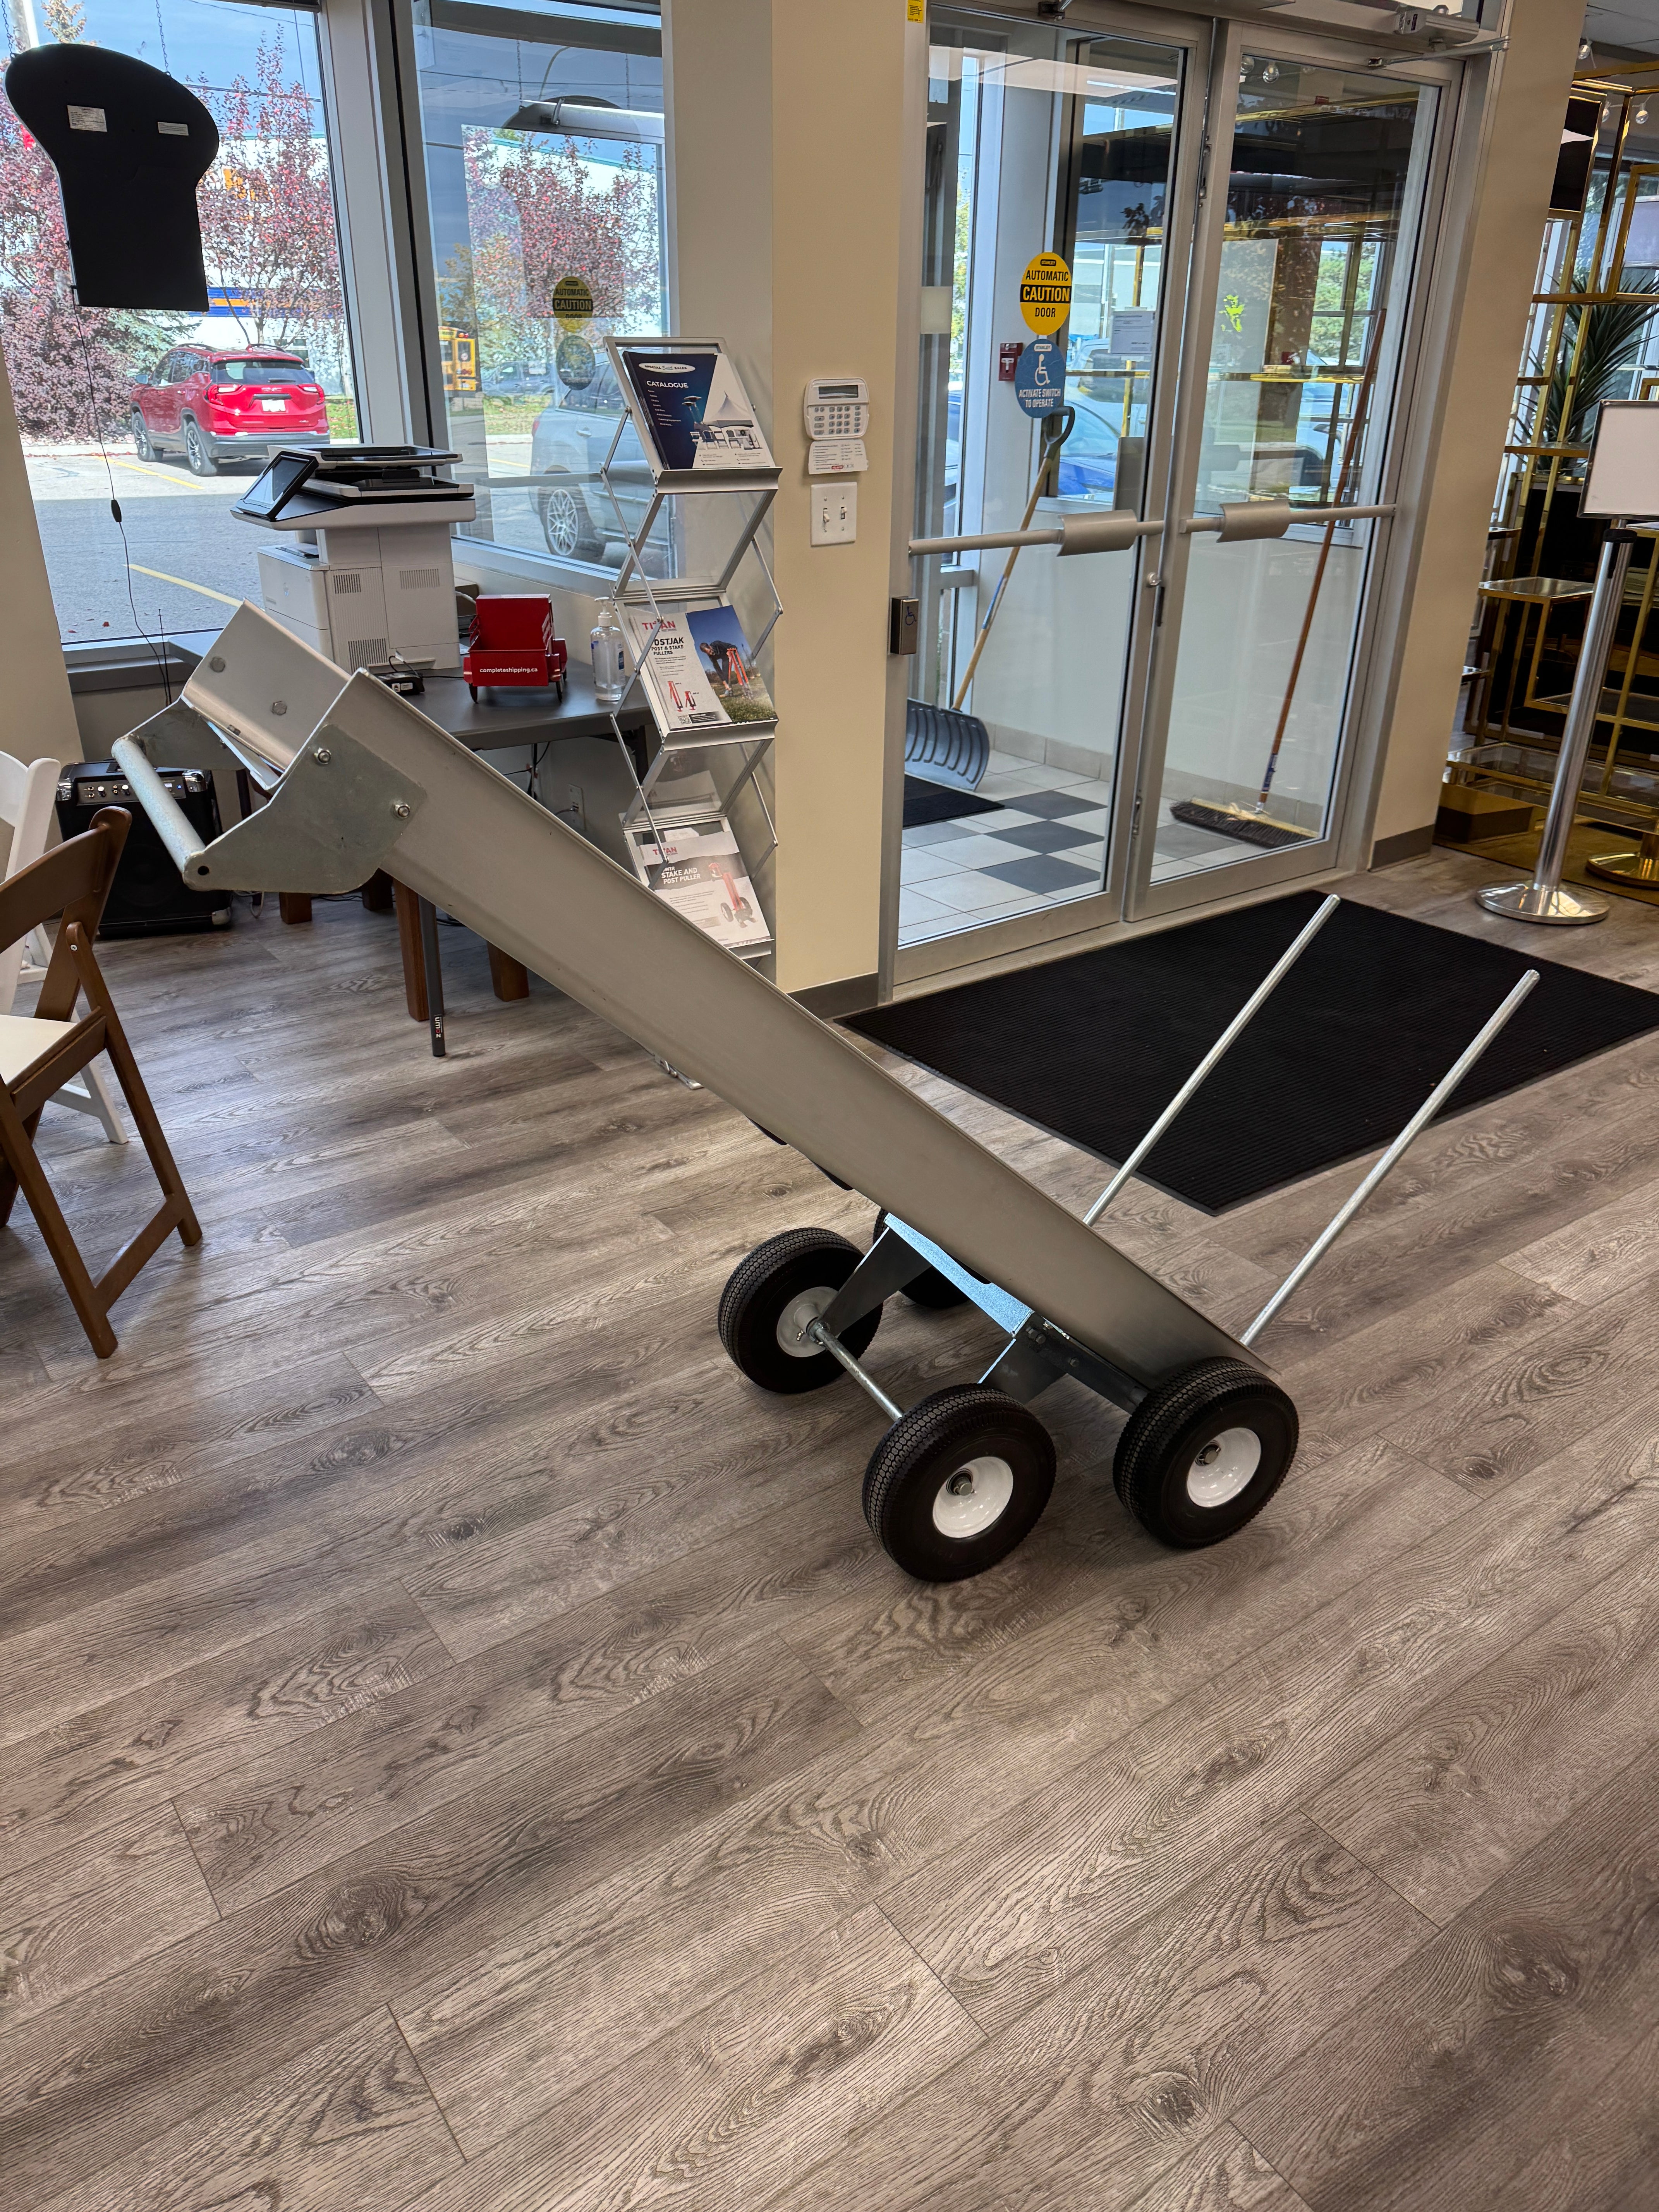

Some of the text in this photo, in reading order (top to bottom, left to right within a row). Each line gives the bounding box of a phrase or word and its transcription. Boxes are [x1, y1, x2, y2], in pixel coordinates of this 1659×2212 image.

[1026, 270, 1068, 281] AUTOMATIC
[1023, 286, 1070, 302] CAUTION
[554, 300, 591, 310] CAUTION
[1035, 307, 1056, 317] DOOR
[1018, 388, 1061, 398] ACTIVATE SWITCH
[1025, 398, 1053, 408] TO OPERATE
[654, 637, 684, 646] OSTJAK
[661, 870, 683, 878] STAKE
[680, 874, 701, 882] PULLER
